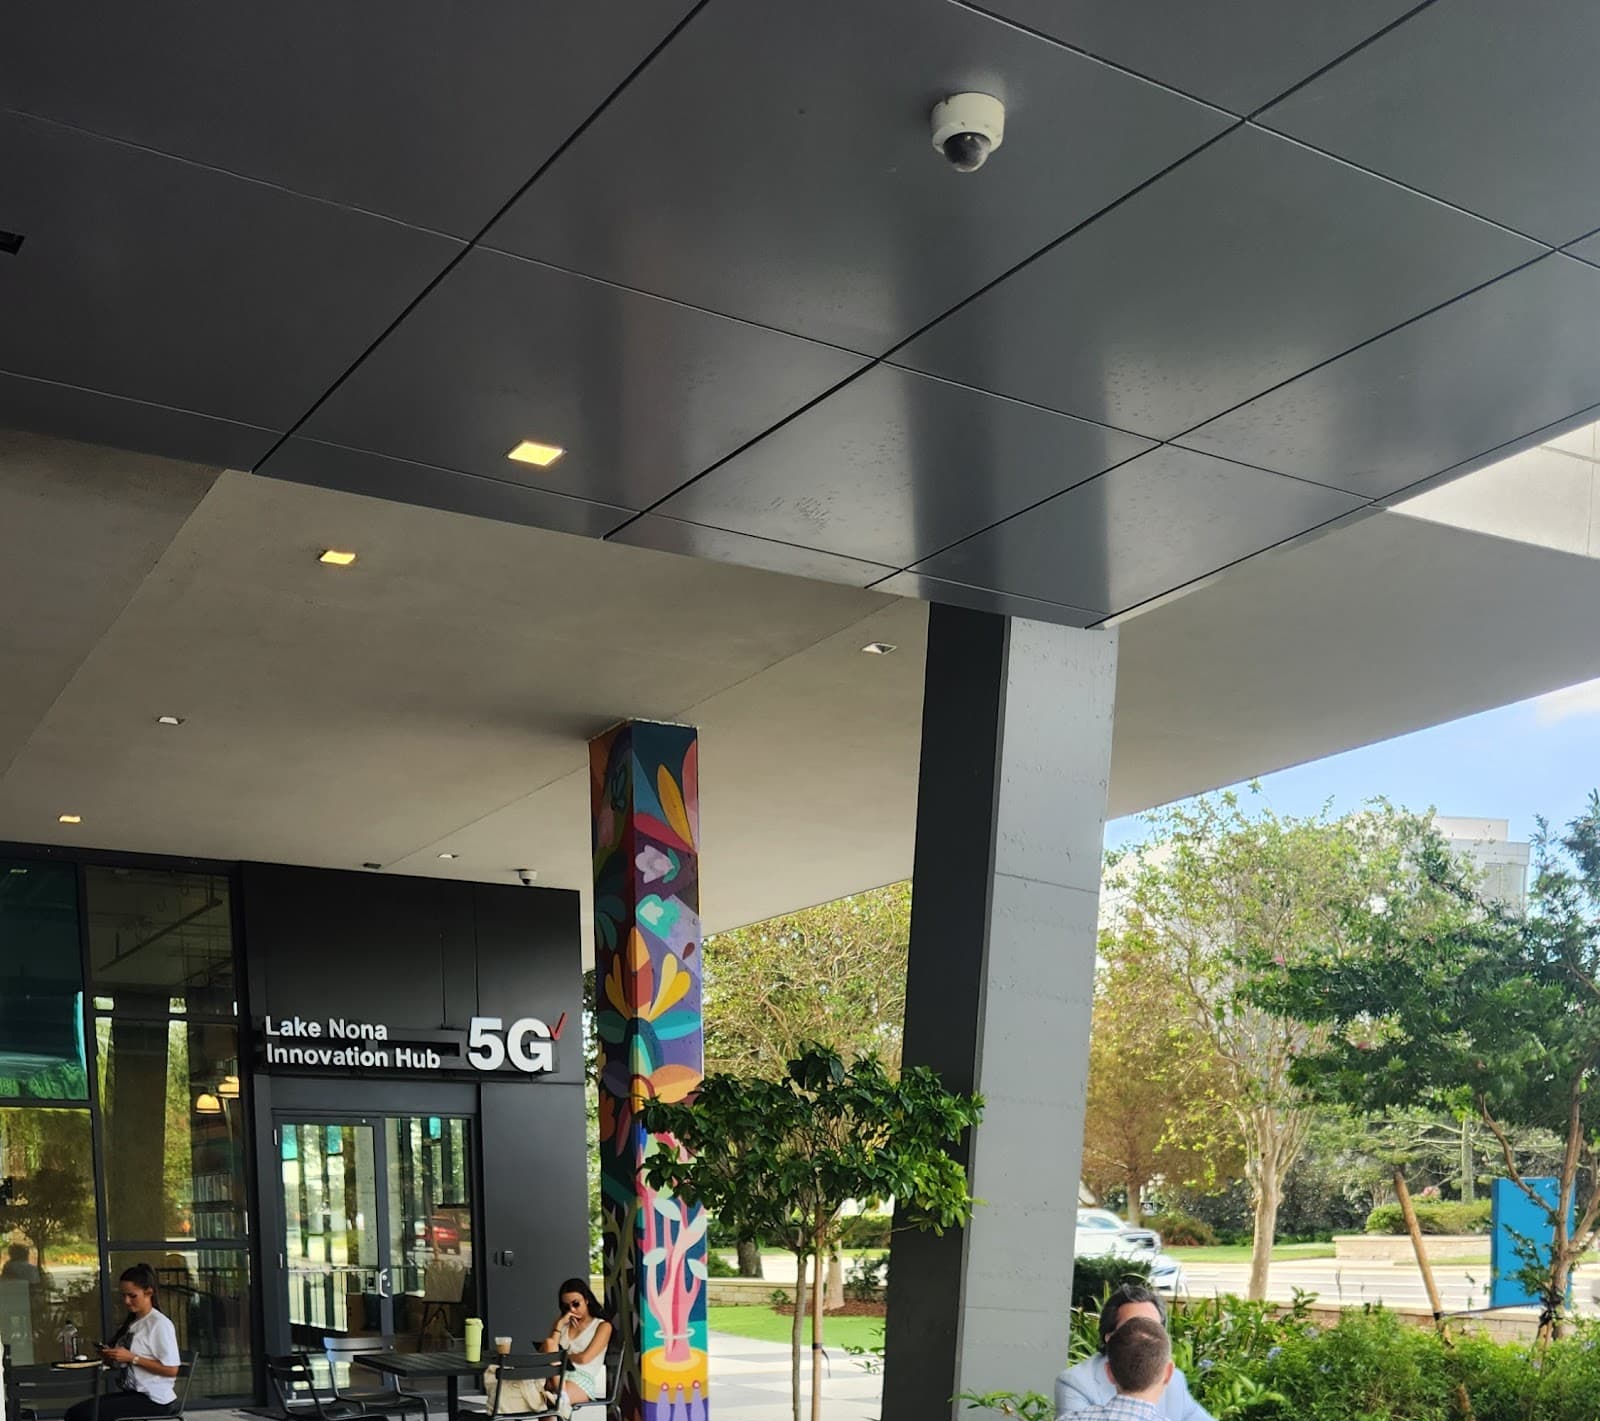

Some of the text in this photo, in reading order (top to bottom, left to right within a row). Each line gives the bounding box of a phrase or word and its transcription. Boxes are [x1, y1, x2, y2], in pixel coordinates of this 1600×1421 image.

[265, 1015, 388, 1041] Lake Nona
[266, 1043, 441, 1070] Innovation Hub
[468, 1016, 553, 1073] 5G
